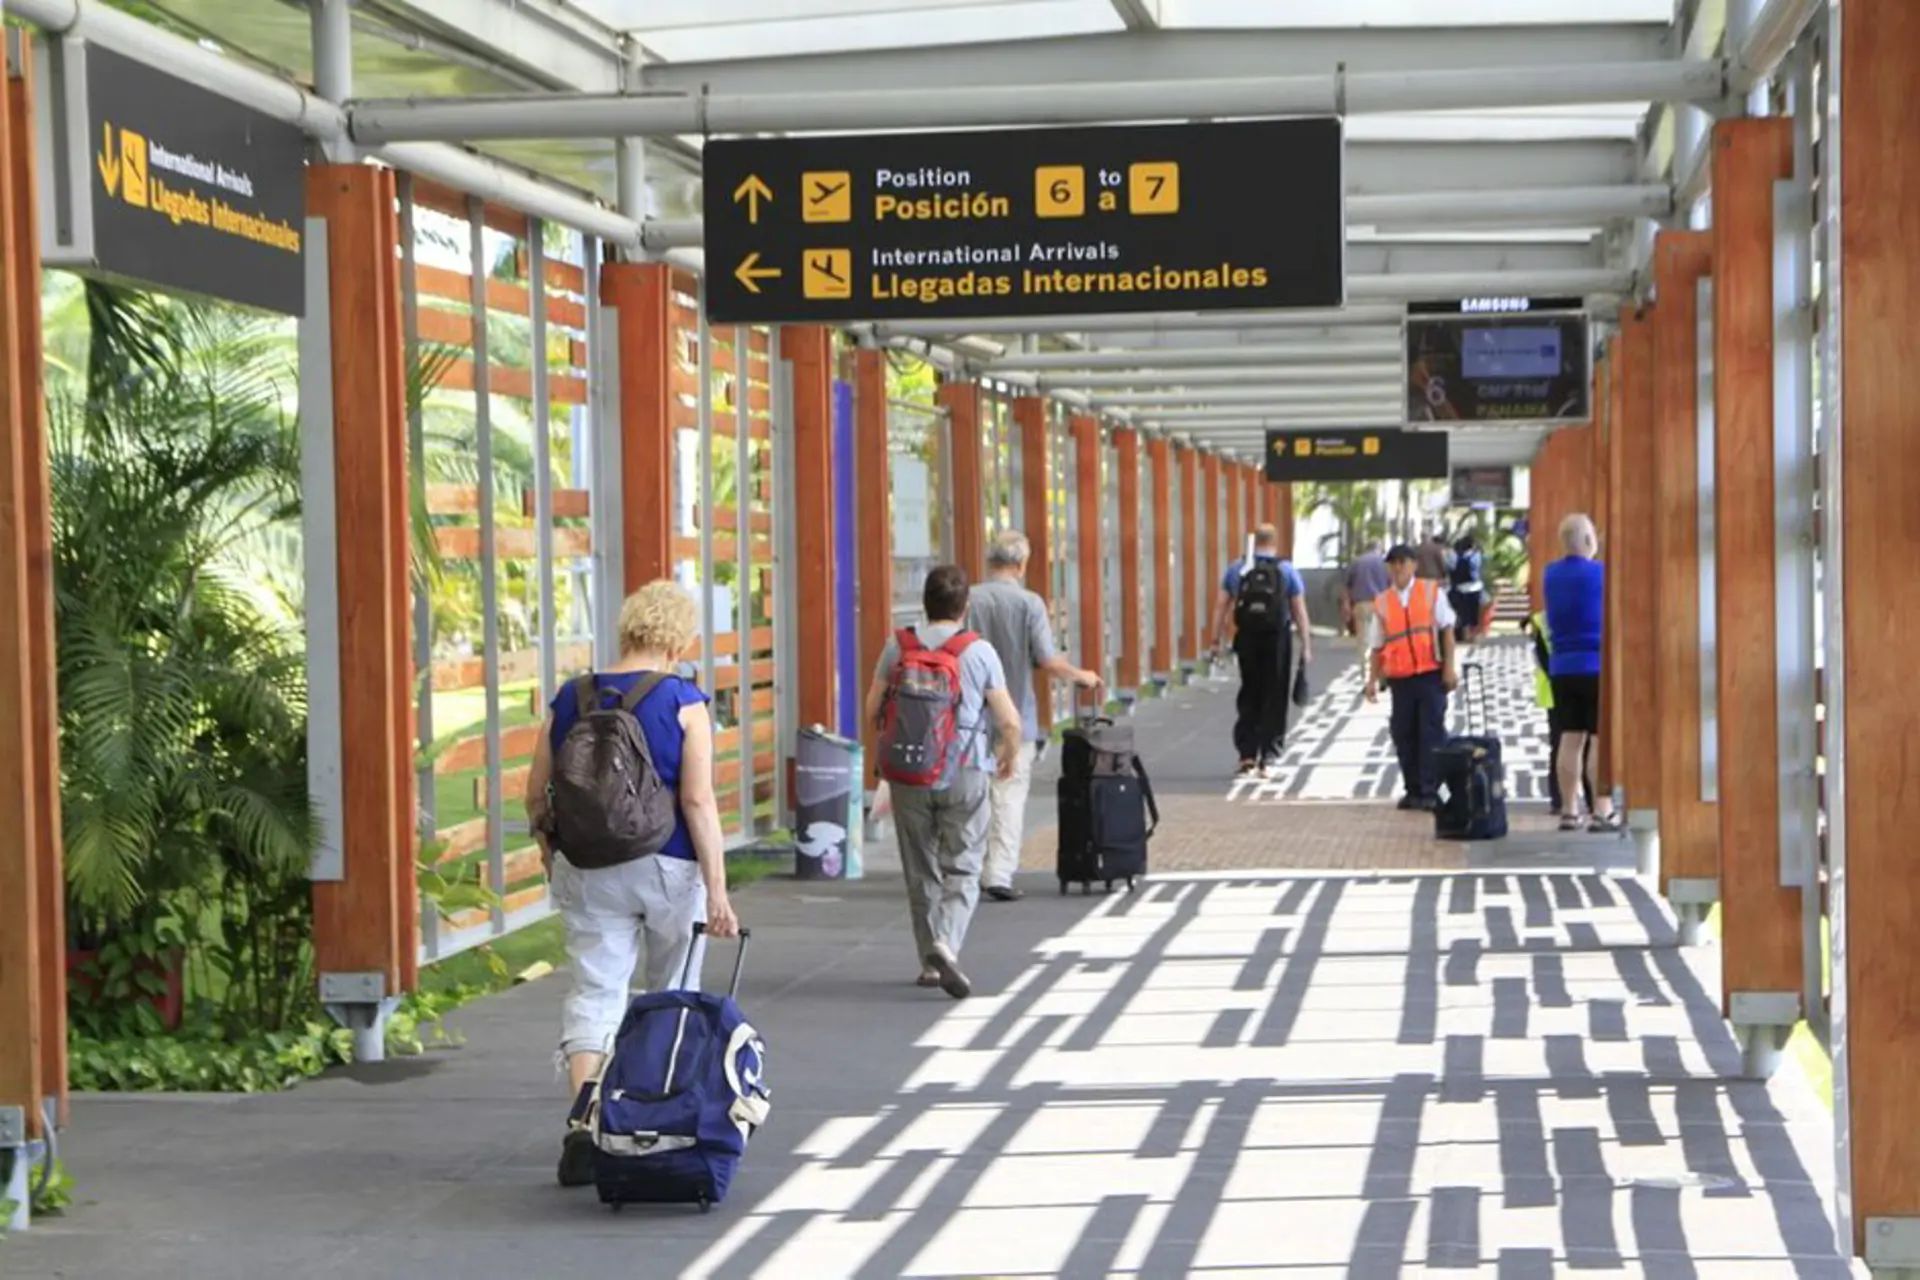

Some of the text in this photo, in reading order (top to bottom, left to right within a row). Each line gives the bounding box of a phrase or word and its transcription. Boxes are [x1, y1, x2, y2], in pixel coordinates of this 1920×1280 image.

[876, 168, 971, 188] Position
[1098, 167, 1121, 187] to
[1146, 176, 1165, 200] 7
[1049, 179, 1070, 203] 6
[1098, 192, 1117, 211] a
[875, 192, 1009, 220] Posición
[872, 241, 1119, 266] International Arrivals
[872, 263, 1268, 303] Llegadas Internacionales
[1460, 296, 1530, 313] SAMSUNG
[1427, 376, 1446, 405] 6
